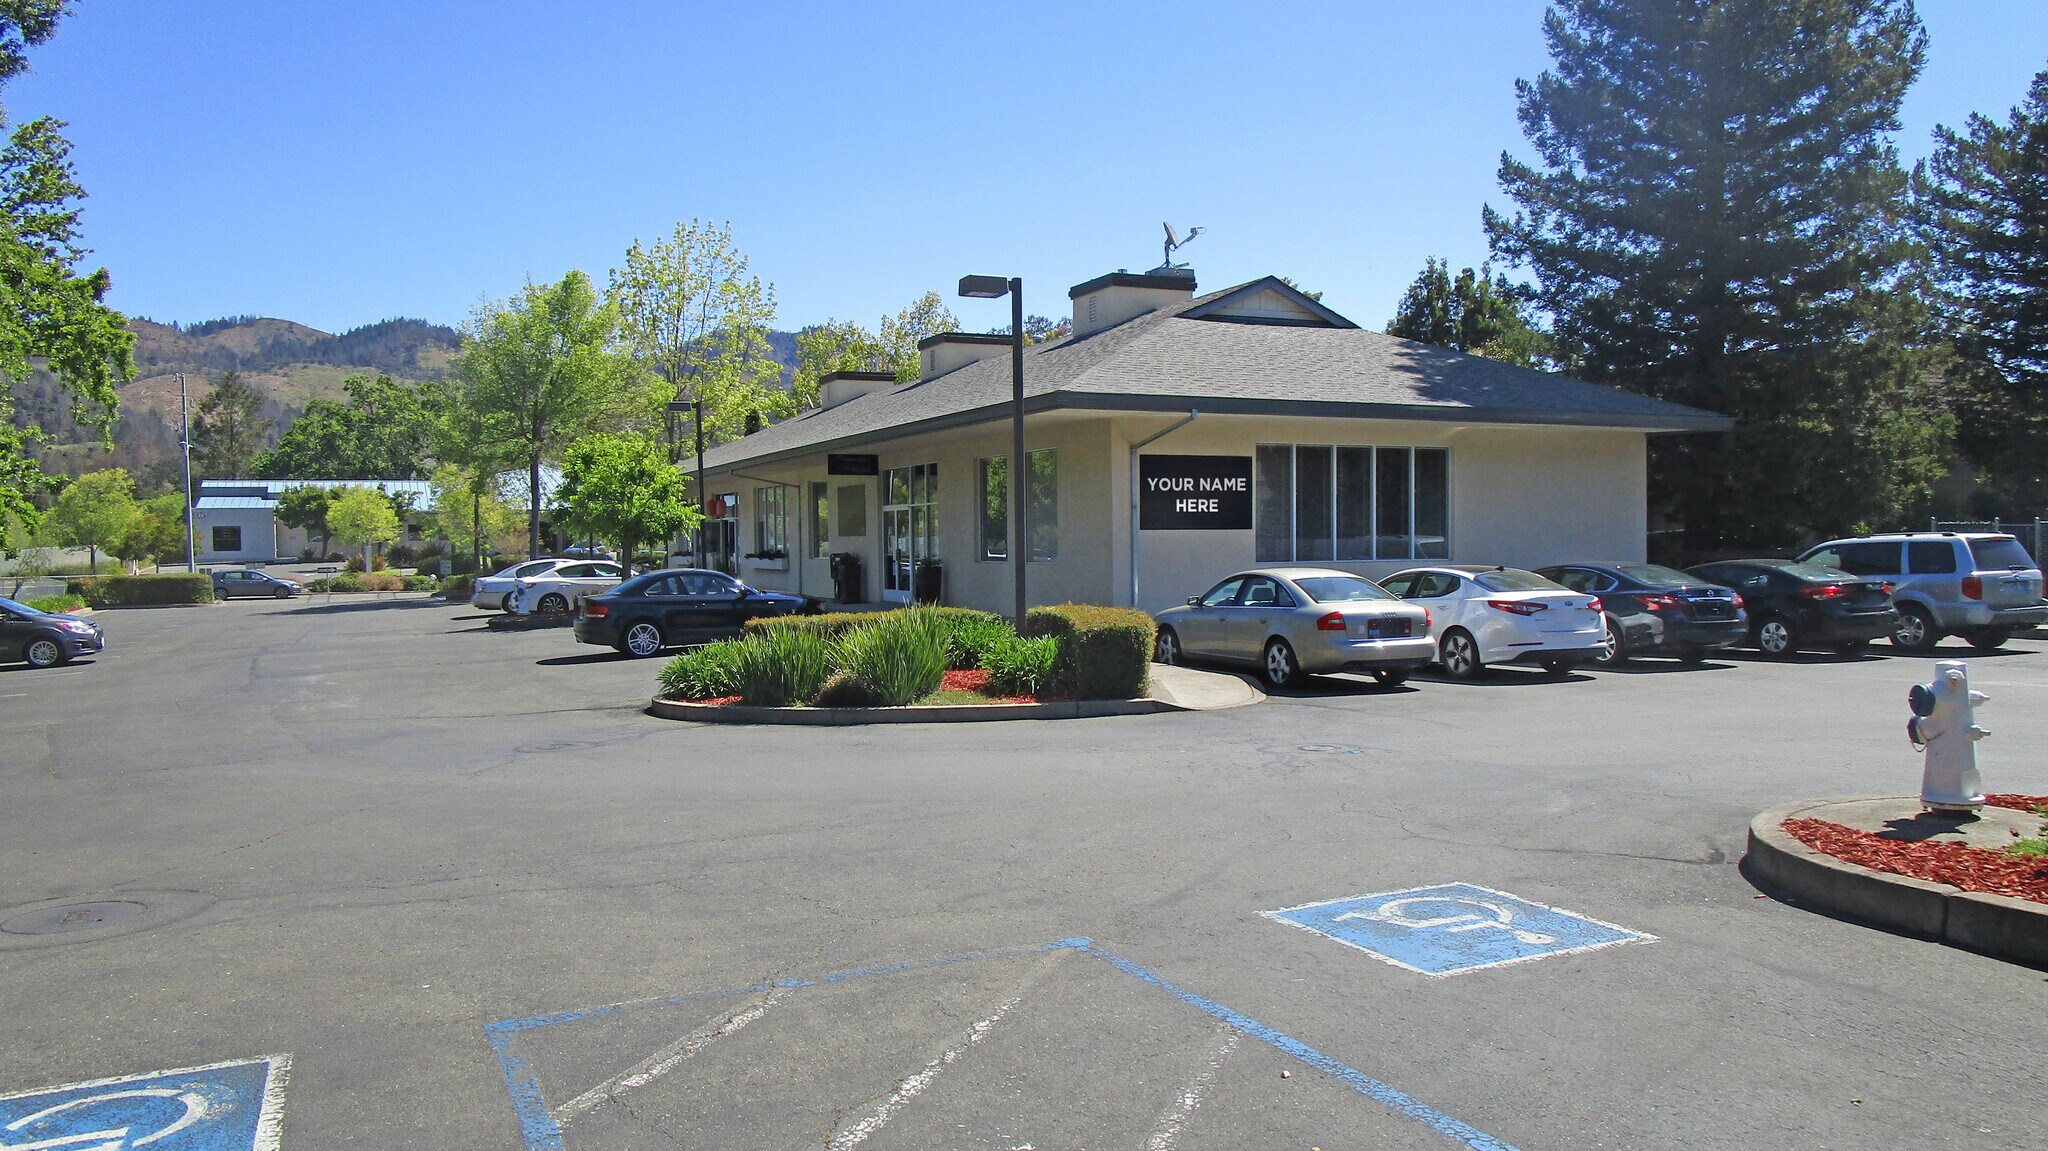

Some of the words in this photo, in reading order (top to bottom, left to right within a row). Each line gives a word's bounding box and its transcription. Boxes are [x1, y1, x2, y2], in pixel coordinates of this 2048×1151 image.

[1147, 477, 1194, 492] YOUR
[1199, 477, 1247, 492] NAME
[1176, 498, 1219, 513] HERE
